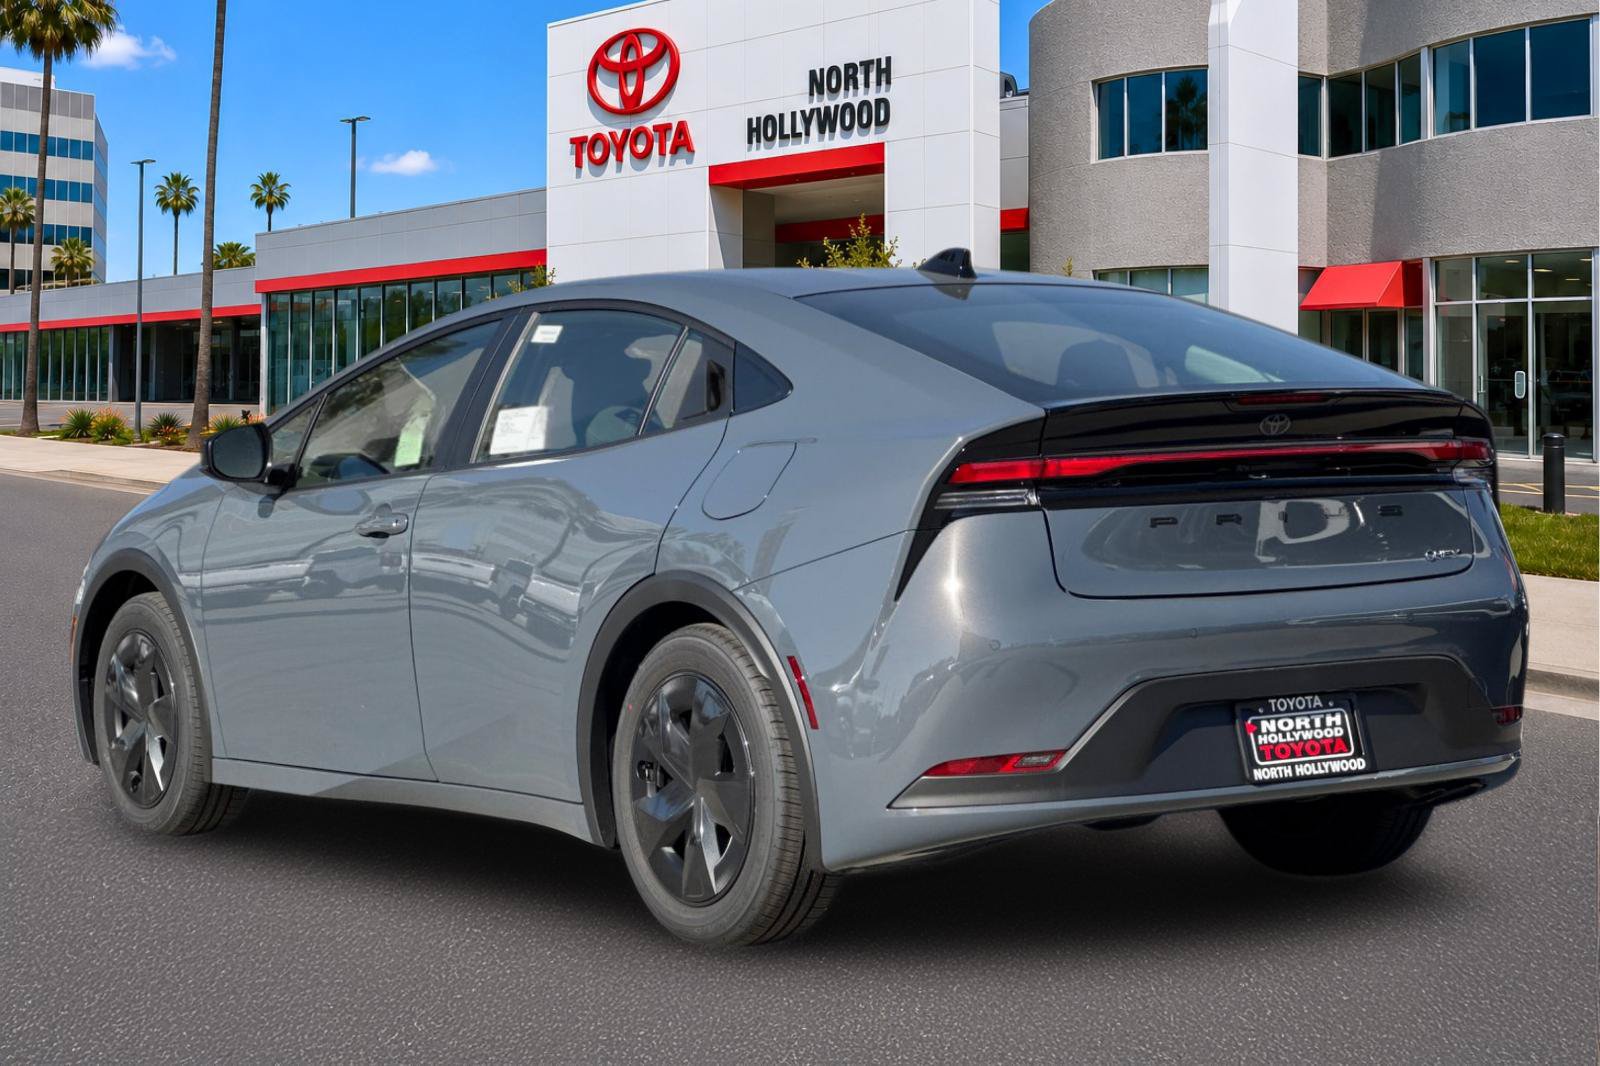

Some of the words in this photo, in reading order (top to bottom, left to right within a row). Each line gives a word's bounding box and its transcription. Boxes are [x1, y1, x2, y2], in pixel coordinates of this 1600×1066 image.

[808, 55, 893, 97] NORTH
[746, 97, 891, 146] HOLLYWOOD
[569, 120, 696, 169] TOYOTA
[1268, 695, 1323, 712] TOYOTA
[1260, 712, 1342, 733] NORTH
[1257, 727, 1344, 745] HOLLYWOOD
[1259, 738, 1349, 761] TOYOTA
[1253, 765, 1293, 781] NORTH
[1295, 758, 1366, 777] HOLLYWOOD
